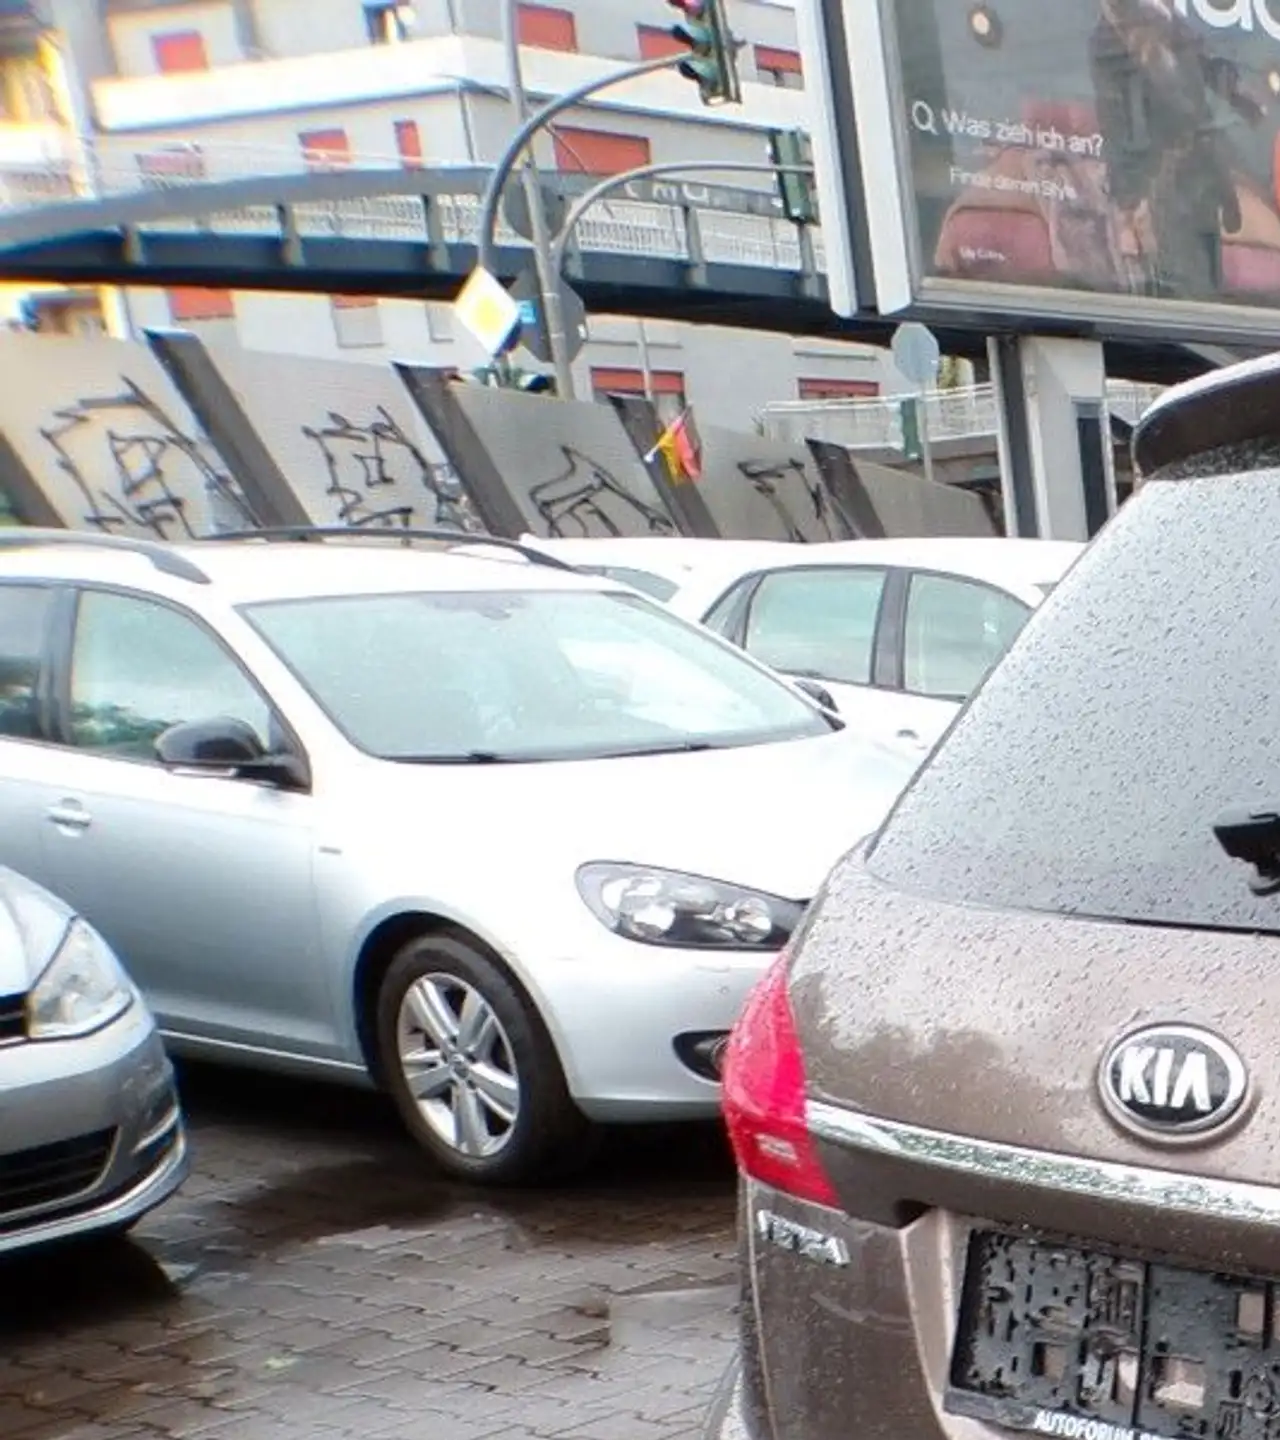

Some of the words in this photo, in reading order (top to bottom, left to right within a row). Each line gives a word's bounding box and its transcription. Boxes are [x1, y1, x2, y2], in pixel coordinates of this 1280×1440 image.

[941, 108, 992, 138] Was
[996, 118, 1033, 145] zieh
[1037, 124, 1064, 150] ich
[1069, 133, 1104, 157] an?
[1120, 1046, 1213, 1111] KIA
